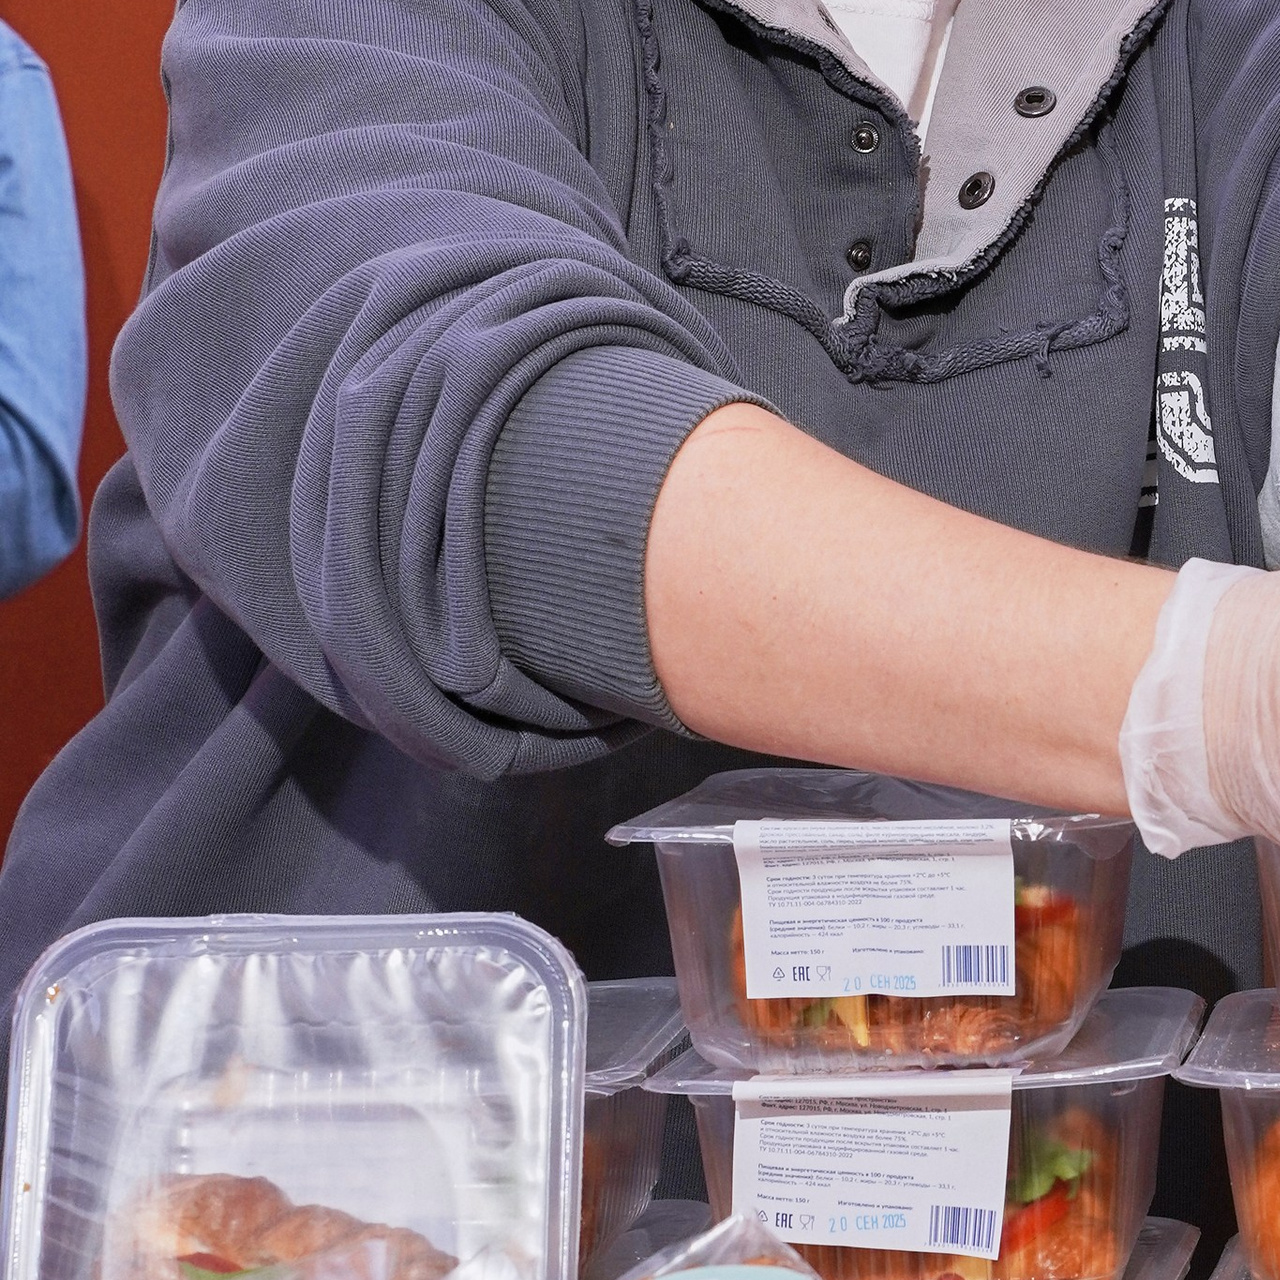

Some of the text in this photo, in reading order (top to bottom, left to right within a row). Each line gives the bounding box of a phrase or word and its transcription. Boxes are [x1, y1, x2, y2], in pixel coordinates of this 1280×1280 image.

[870, 975, 890, 988] СЕН
[894, 975, 916, 991] 2025
[856, 1215, 878, 1230] СЕН
[883, 1213, 906, 1229] 2025
